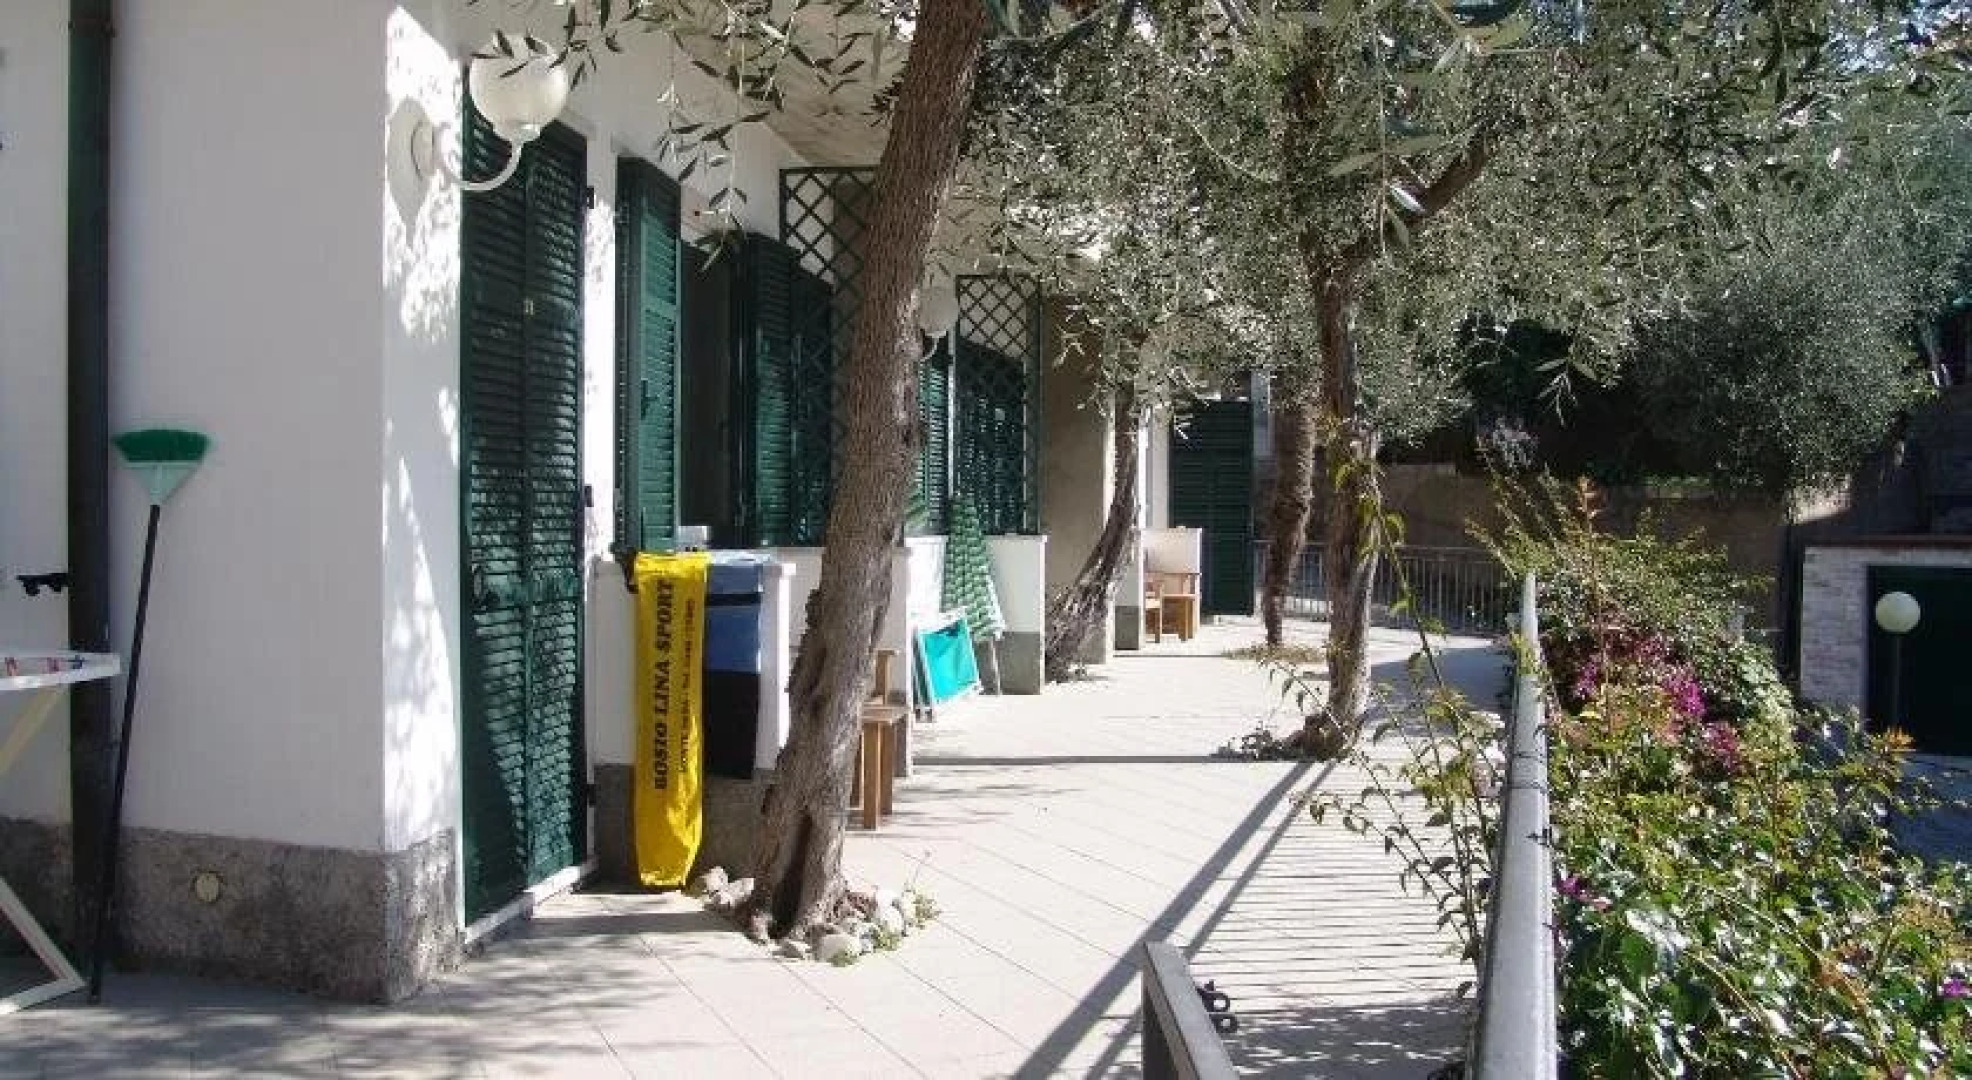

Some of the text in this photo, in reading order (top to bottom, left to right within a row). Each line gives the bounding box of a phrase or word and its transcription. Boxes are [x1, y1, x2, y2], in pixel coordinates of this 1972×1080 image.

[654, 578, 672, 790] BOSIO LINA SPORT
